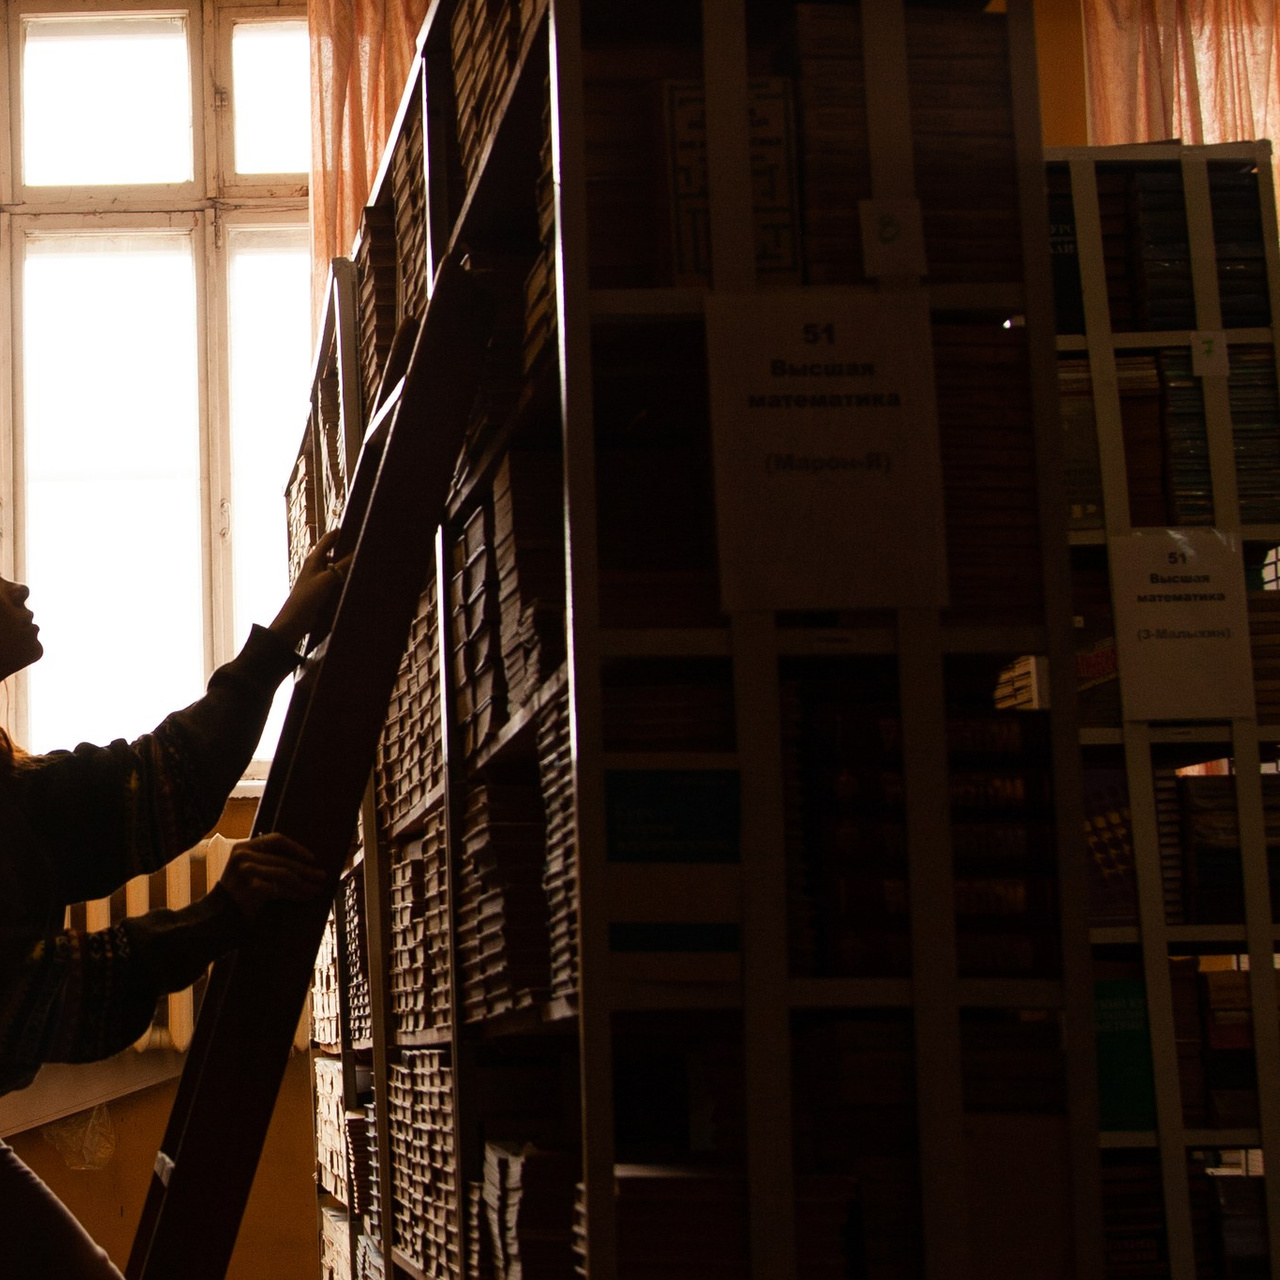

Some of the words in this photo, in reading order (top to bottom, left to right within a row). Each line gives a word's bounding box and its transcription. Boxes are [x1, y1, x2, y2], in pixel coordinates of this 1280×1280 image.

[803, 322, 835, 344] 51
[770, 358, 876, 377] Высшая
[747, 392, 902, 408] математика
[1167, 551, 1188, 565] 51
[1149, 572, 1211, 584] Высшая
[1136, 592, 1226, 603] математика
